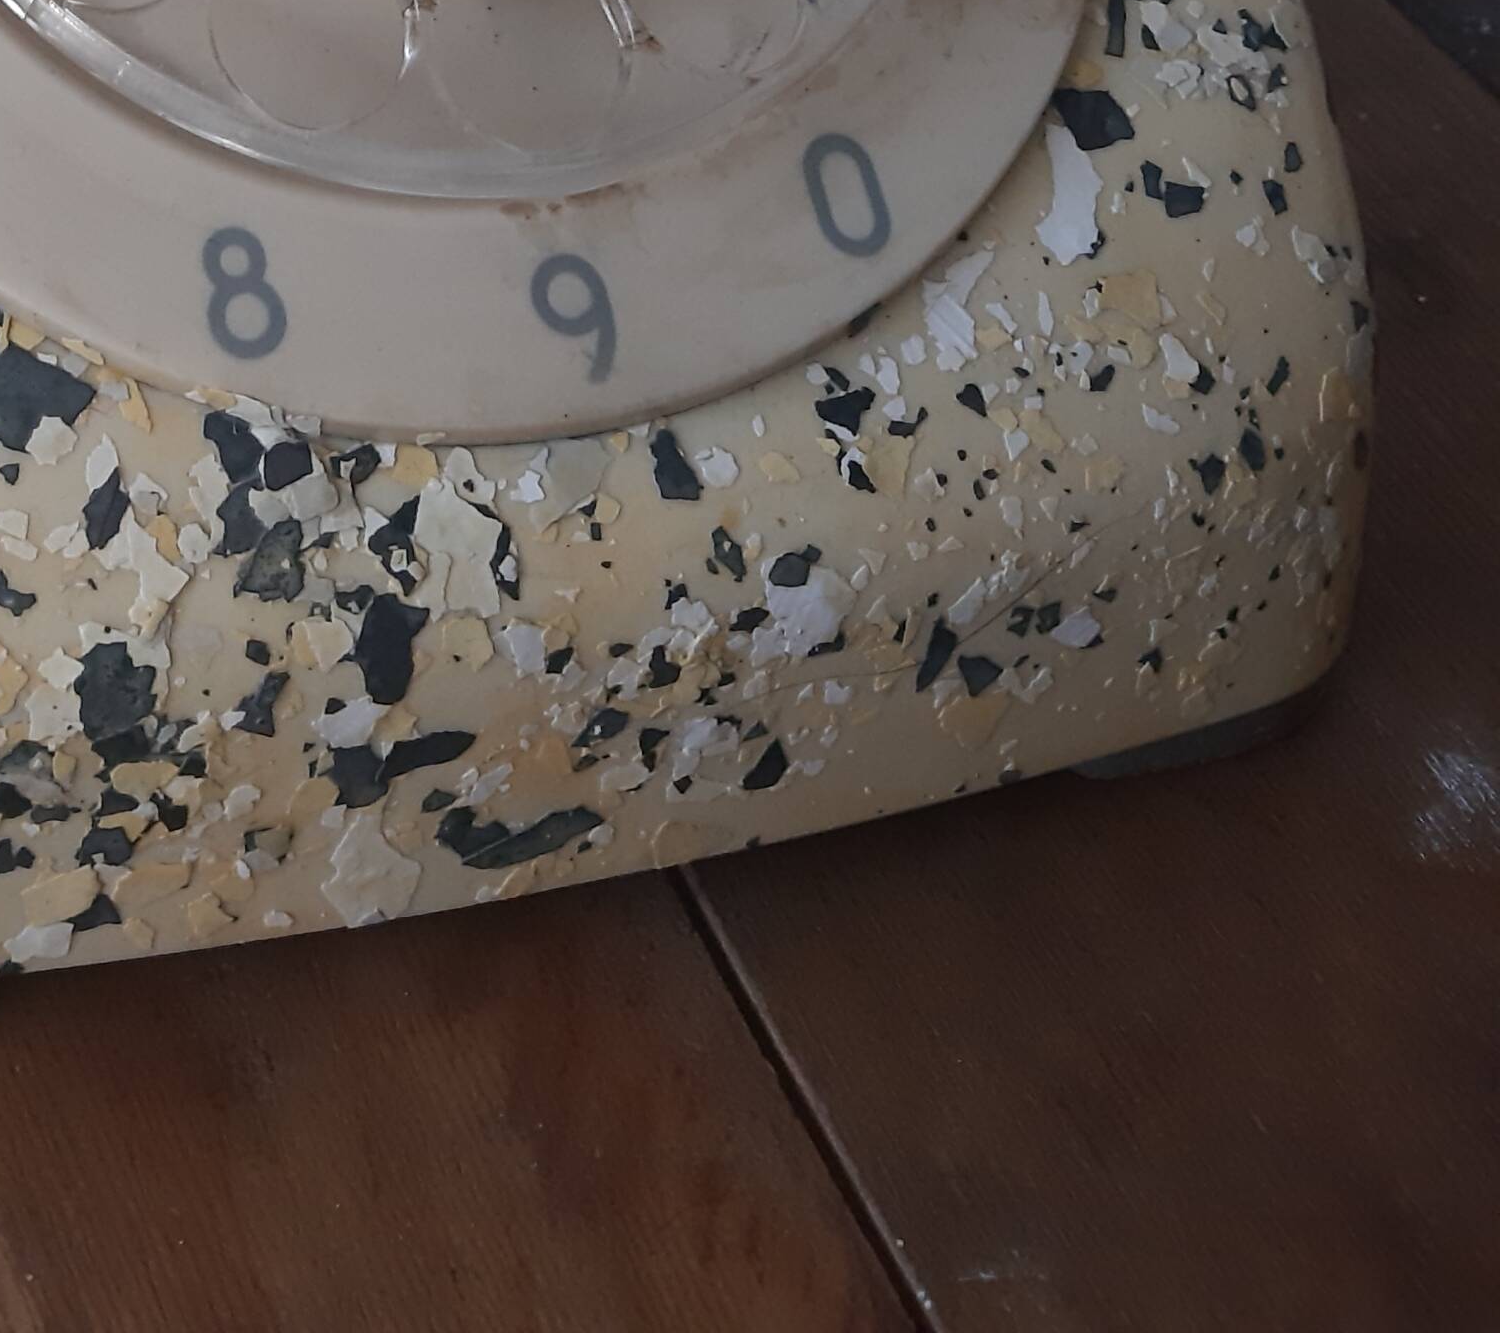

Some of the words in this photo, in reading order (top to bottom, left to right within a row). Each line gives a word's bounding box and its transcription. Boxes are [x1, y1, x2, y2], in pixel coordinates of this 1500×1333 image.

[802, 133, 891, 256] 0
[202, 228, 287, 359] 8
[531, 254, 616, 381] 9
